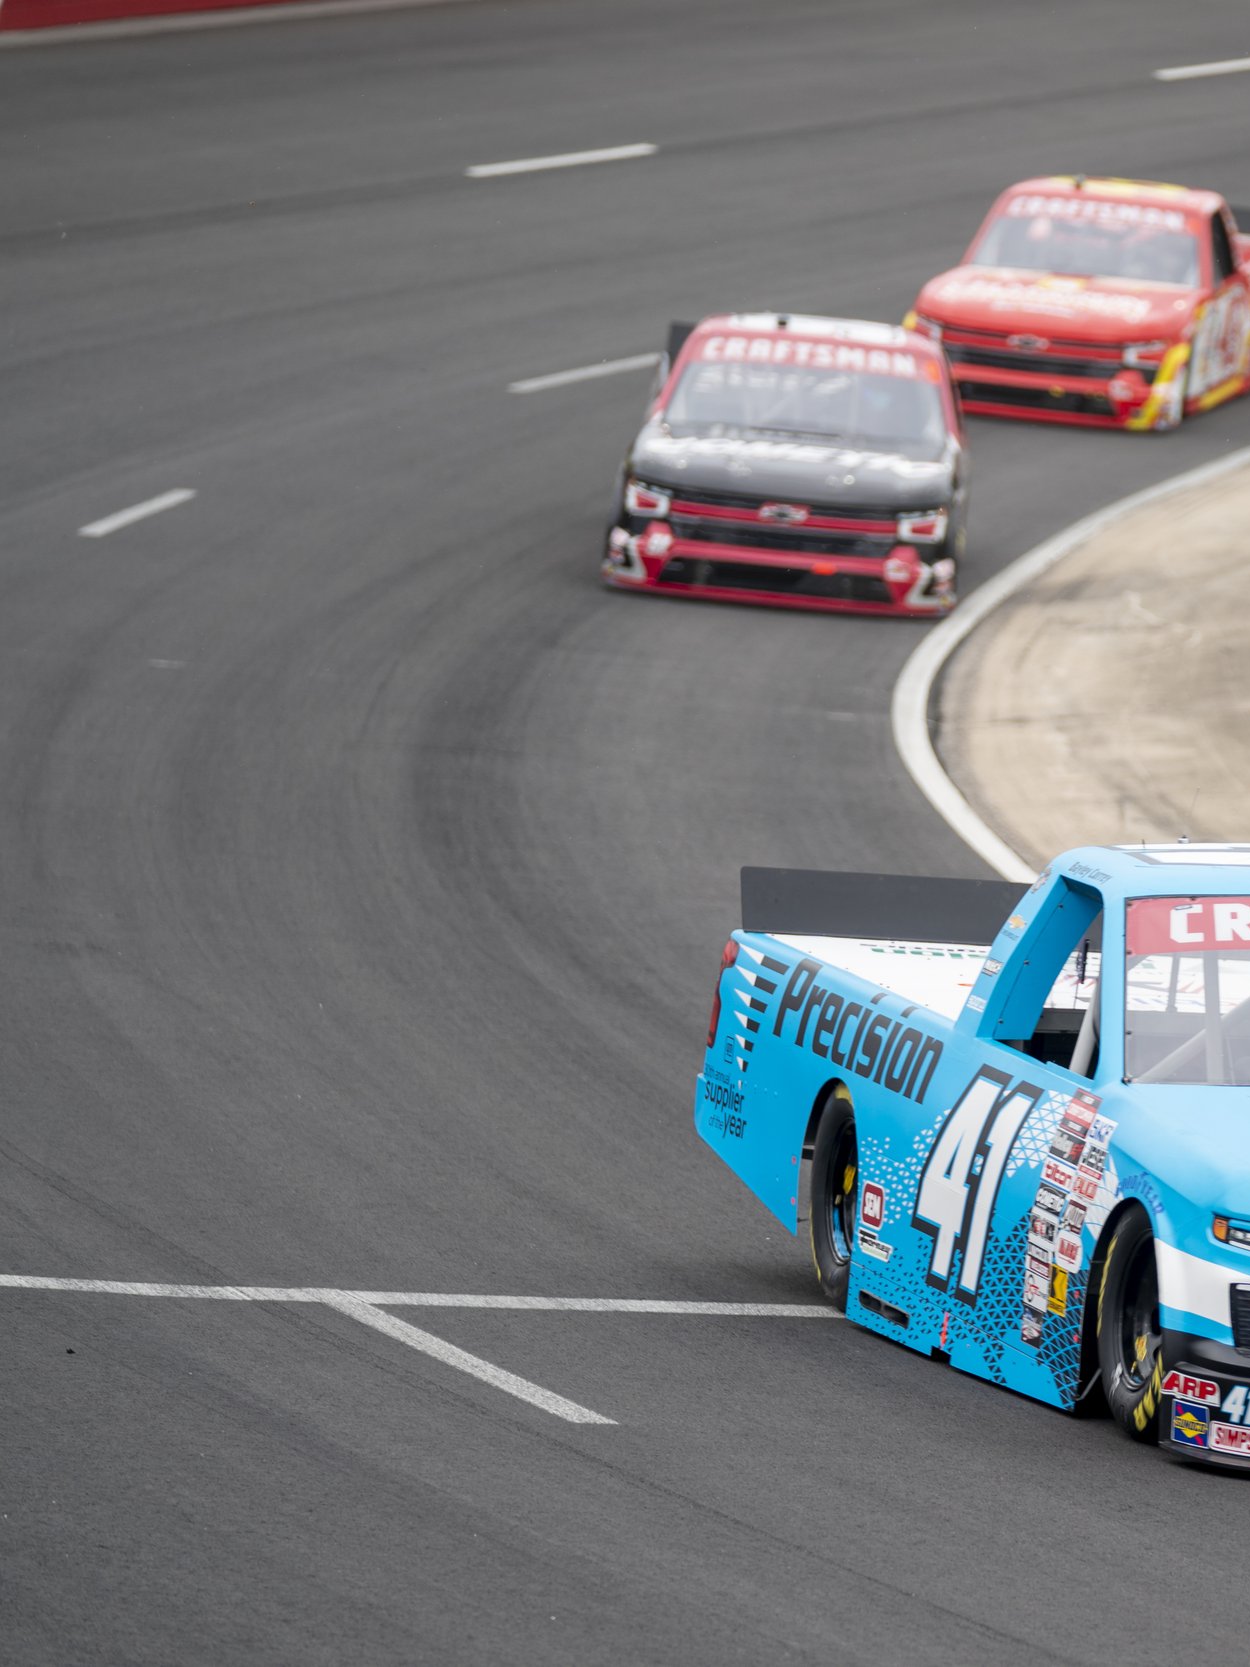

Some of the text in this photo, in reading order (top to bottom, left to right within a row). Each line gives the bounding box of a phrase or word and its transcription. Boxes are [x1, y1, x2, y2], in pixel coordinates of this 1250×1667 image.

[703, 337, 917, 375] CRAFTSMAN
[773, 958, 944, 1105] Precision
[705, 1080, 745, 1113] supplier
[723, 1112, 747, 1139] year
[911, 1066, 1042, 1303] 41
[1163, 1372, 1217, 1400] ARP
